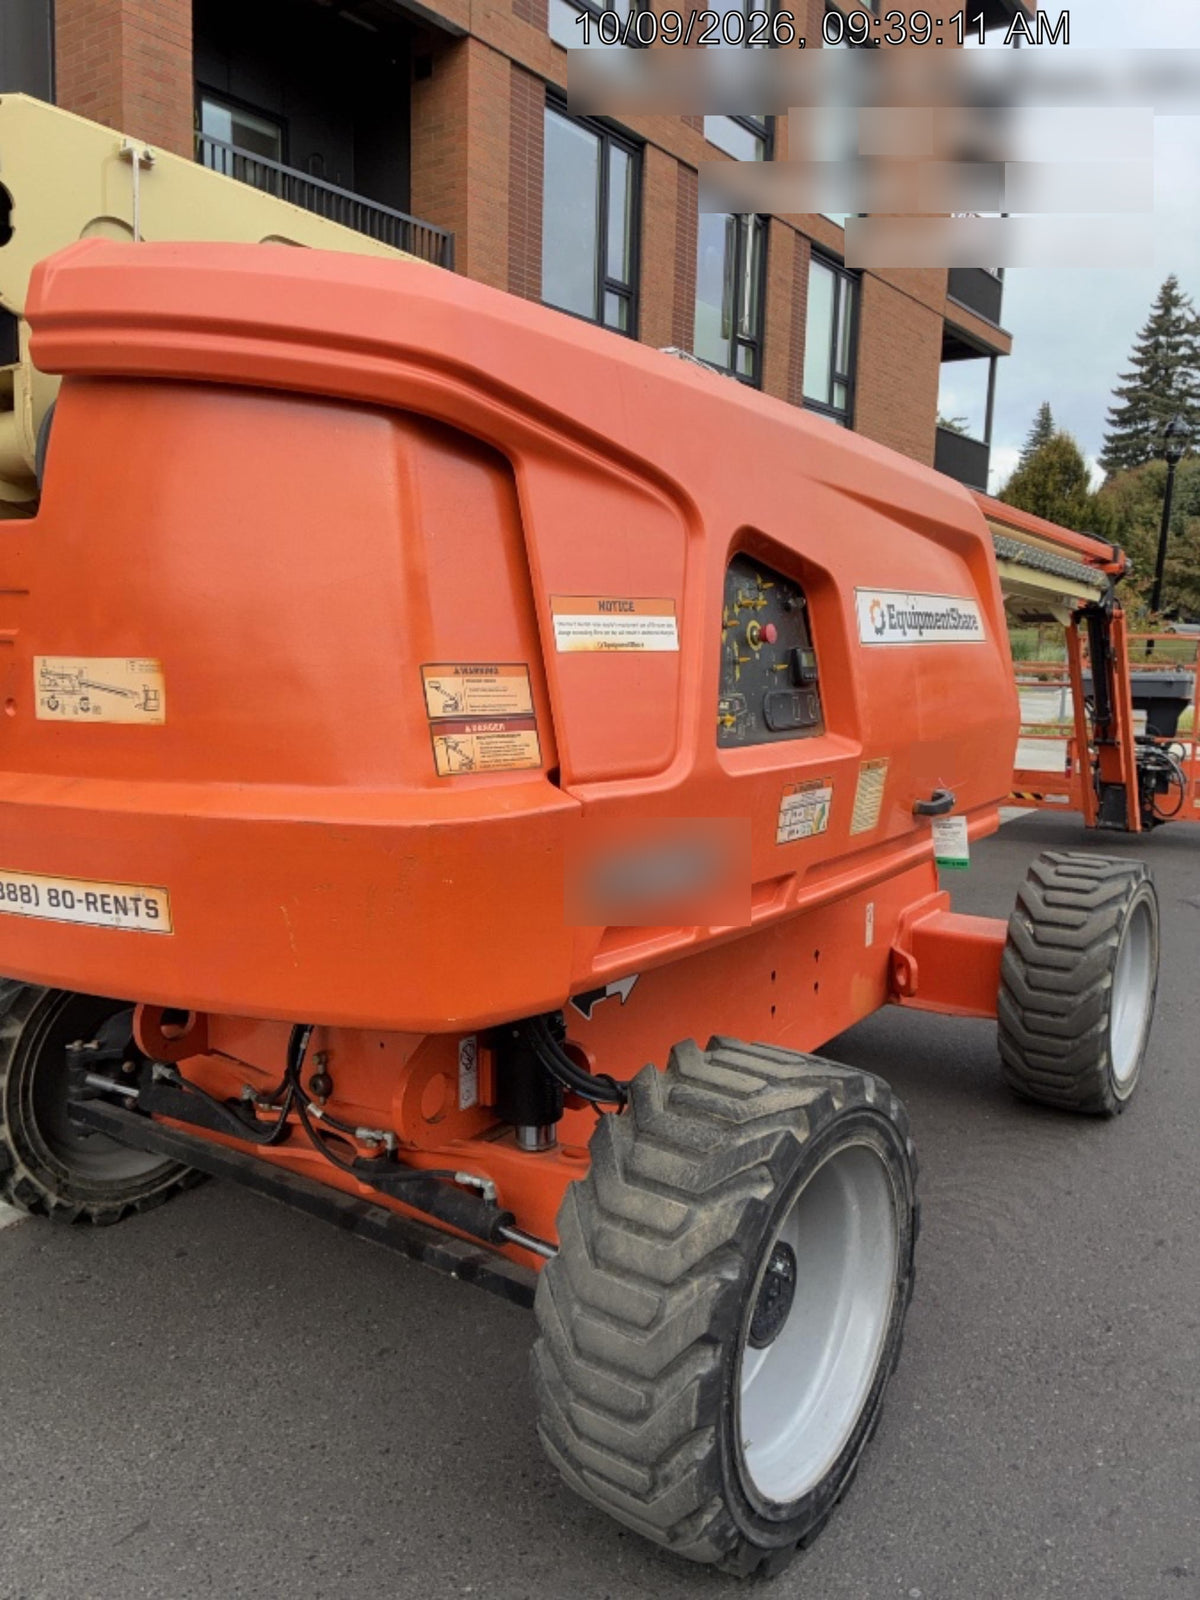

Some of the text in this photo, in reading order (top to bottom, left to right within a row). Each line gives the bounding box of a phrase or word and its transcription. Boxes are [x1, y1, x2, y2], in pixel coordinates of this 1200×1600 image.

[597, 600, 636, 613] NOTICE
[886, 603, 979, 637] EquipmentShare
[47, 887, 160, 920] 80-RENTS
